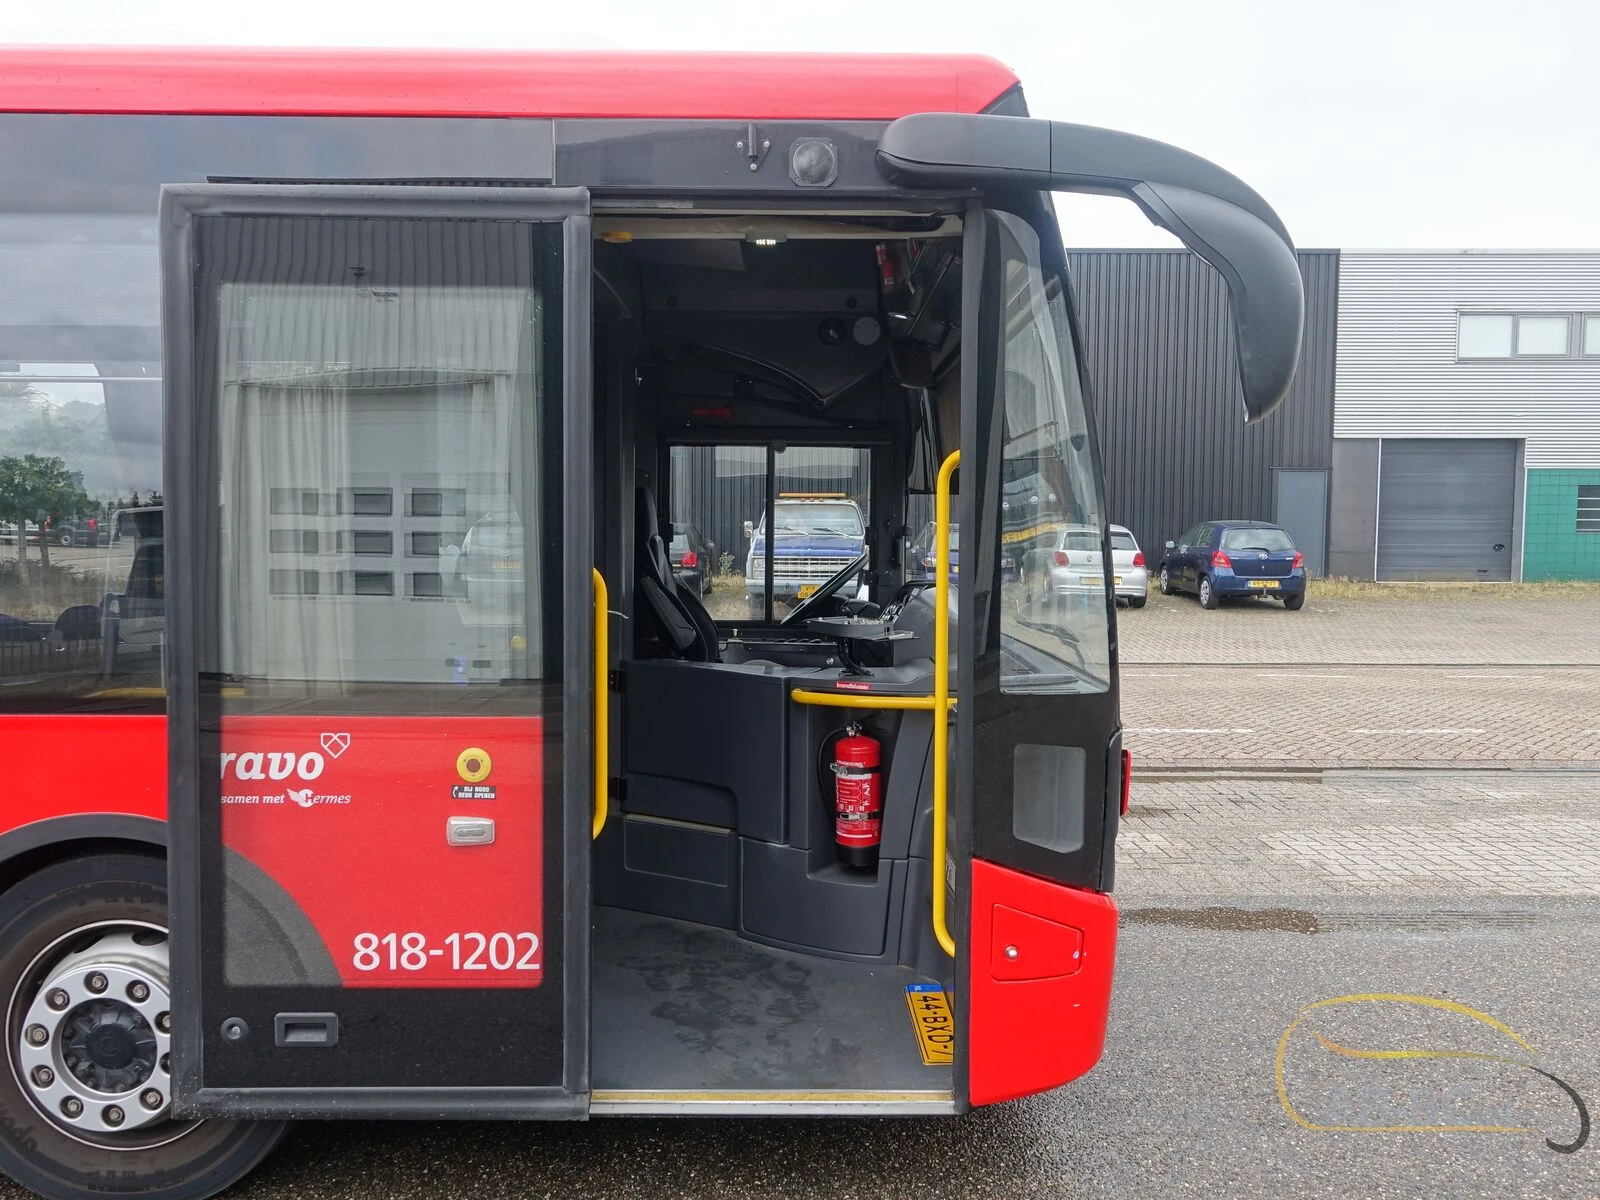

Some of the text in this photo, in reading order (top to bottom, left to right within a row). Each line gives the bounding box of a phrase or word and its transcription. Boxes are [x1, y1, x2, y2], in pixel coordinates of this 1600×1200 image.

[221, 794, 259, 804] samen
[262, 794, 285, 804] met
[352, 932, 540, 971] 818-1202
